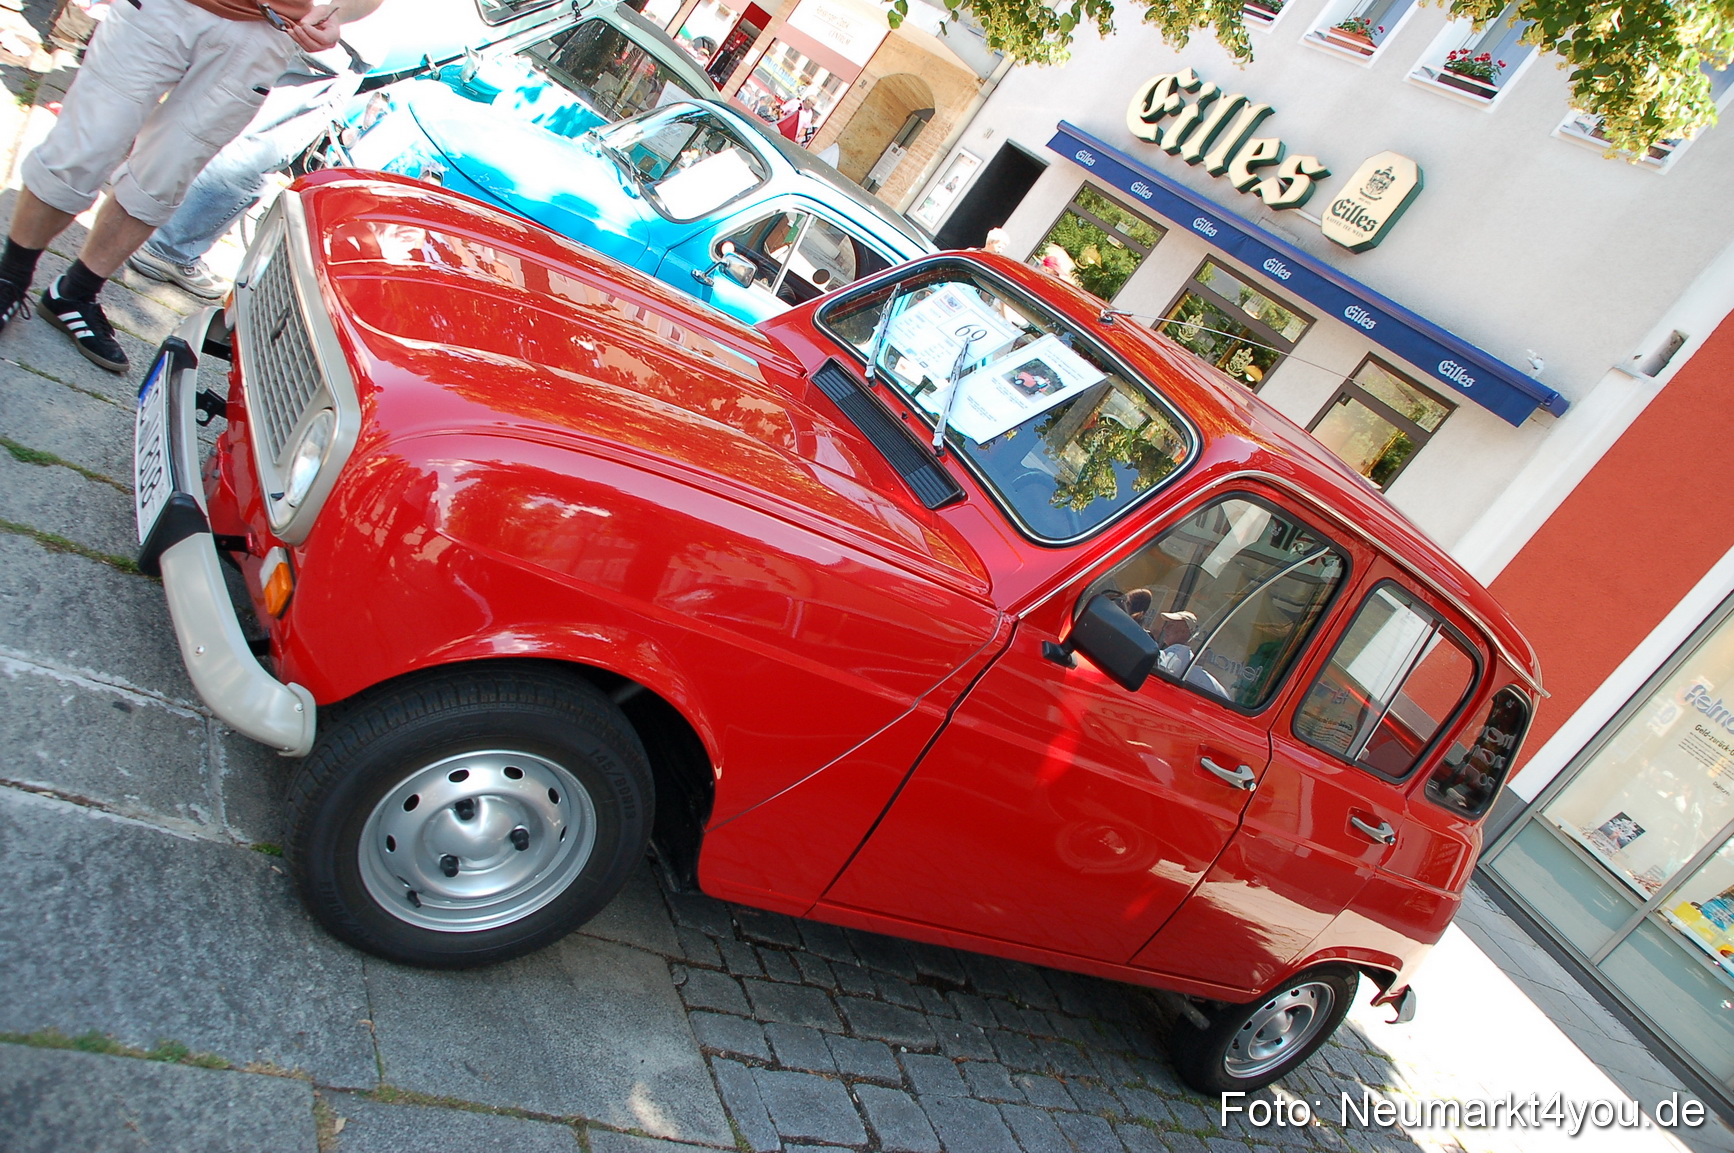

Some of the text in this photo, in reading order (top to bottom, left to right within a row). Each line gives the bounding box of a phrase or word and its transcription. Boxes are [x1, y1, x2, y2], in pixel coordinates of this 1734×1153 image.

[1126, 67, 1332, 211] Eilles
[1075, 150, 1096, 167] Eilles
[1130, 181, 1153, 200] Eilles
[1192, 217, 1218, 237] Eilles
[1331, 198, 1378, 232] Eilles
[1263, 257, 1292, 281] Eilles
[1344, 304, 1377, 330] Eilles
[954, 324, 987, 342] 69
[1437, 359, 1476, 389] Eilles
